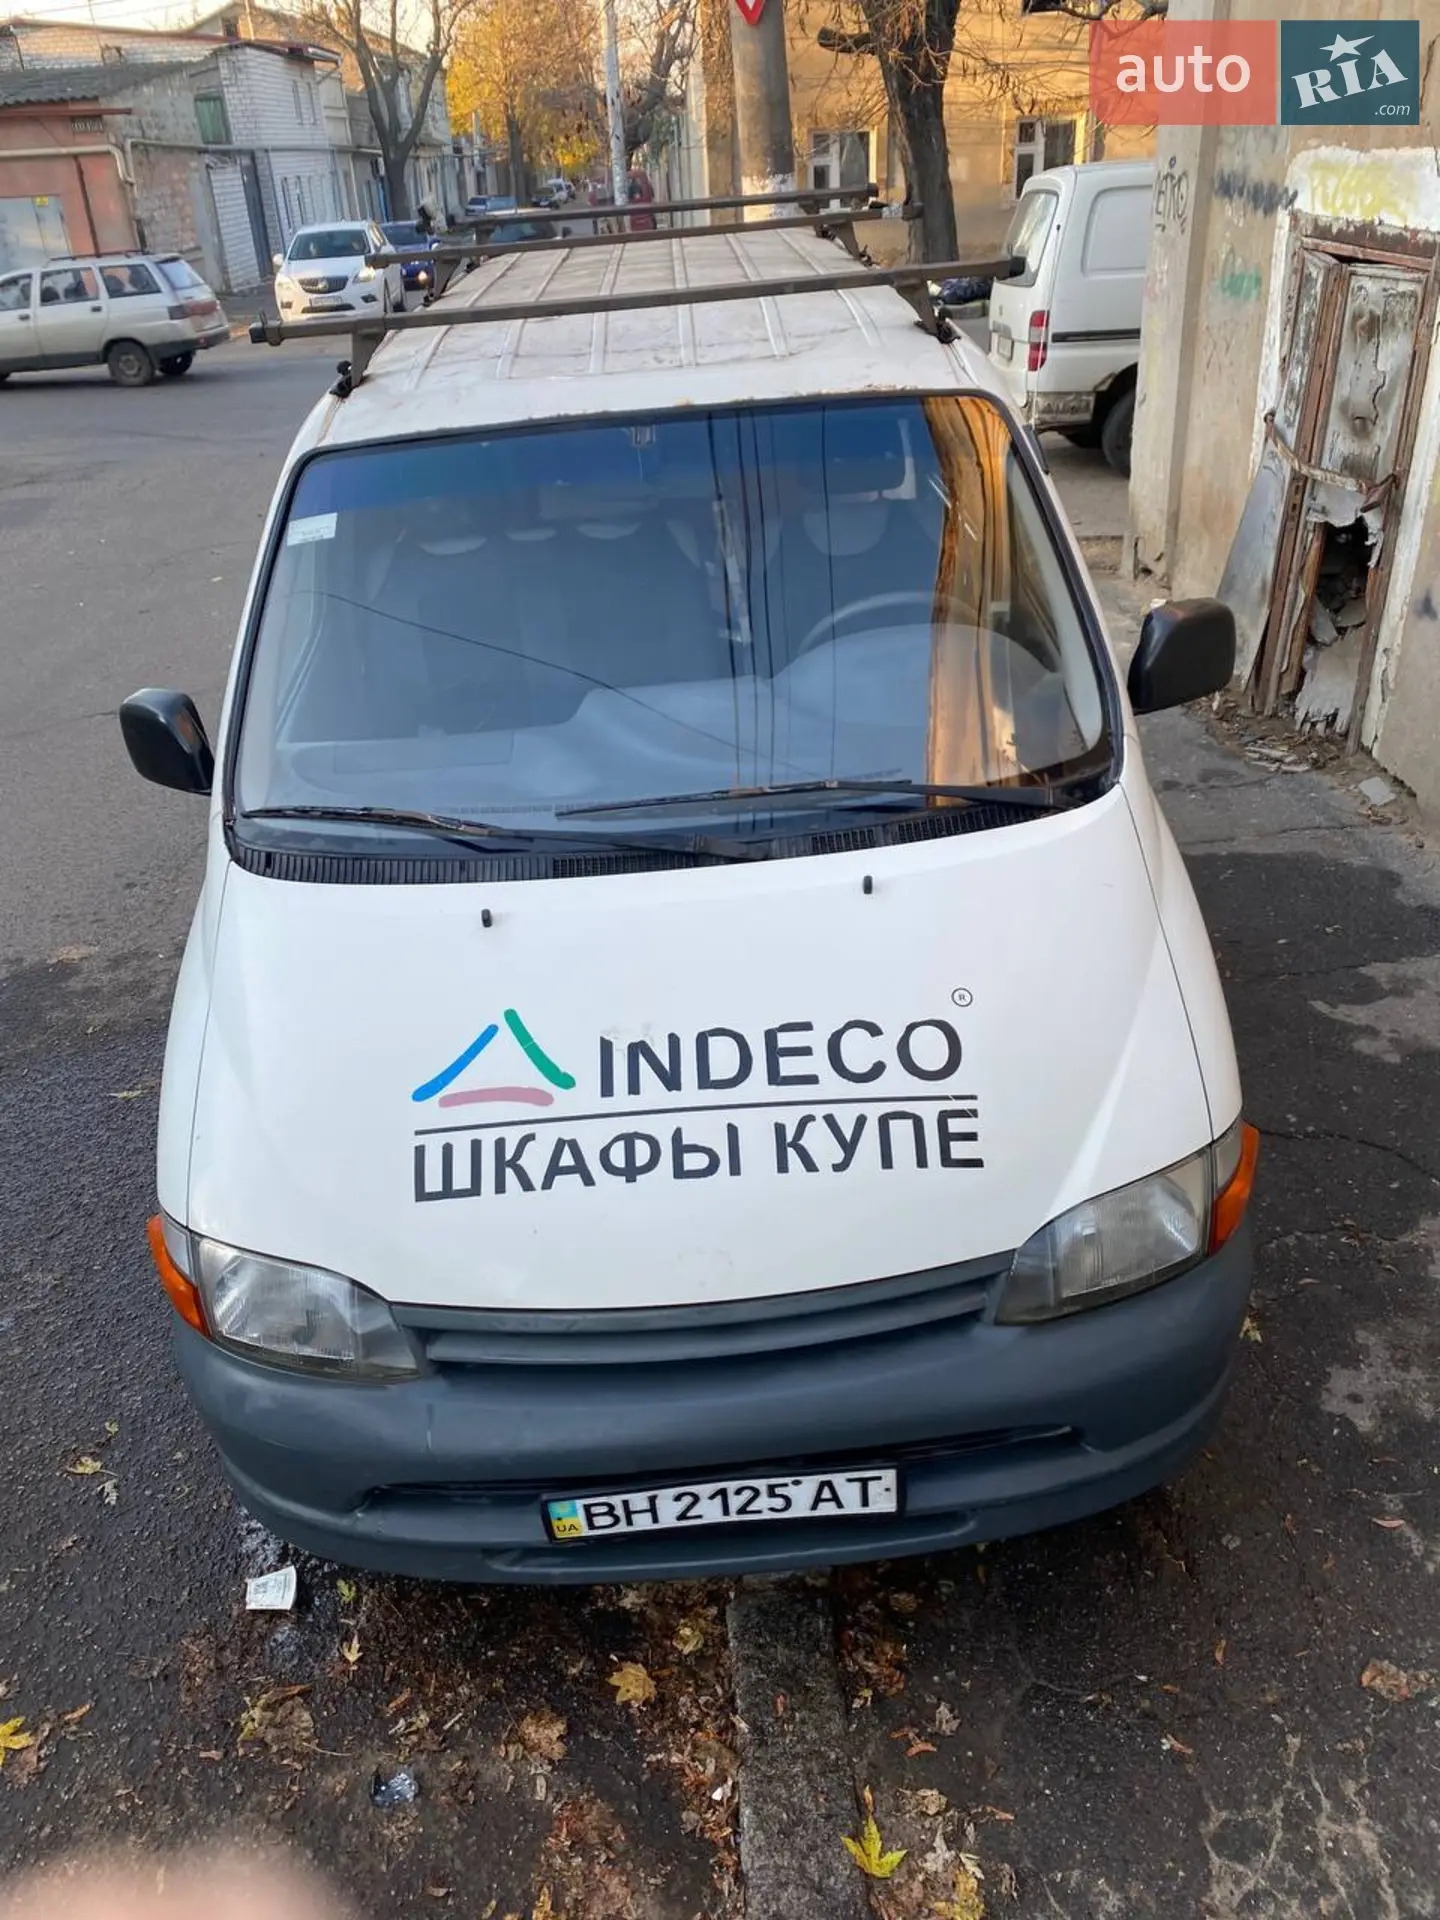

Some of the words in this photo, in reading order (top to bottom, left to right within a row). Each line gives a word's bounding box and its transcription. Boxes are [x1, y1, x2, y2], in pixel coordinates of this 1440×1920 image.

[600, 1018, 963, 1098] INDECO
[414, 1123, 742, 1202] ШКАФЫ
[774, 1109, 985, 1174] КУПЕ
[556, 1523, 578, 1533] UA
[582, 1494, 660, 1531] BH
[672, 1482, 793, 1522] 2125
[810, 1475, 883, 1511] AT
